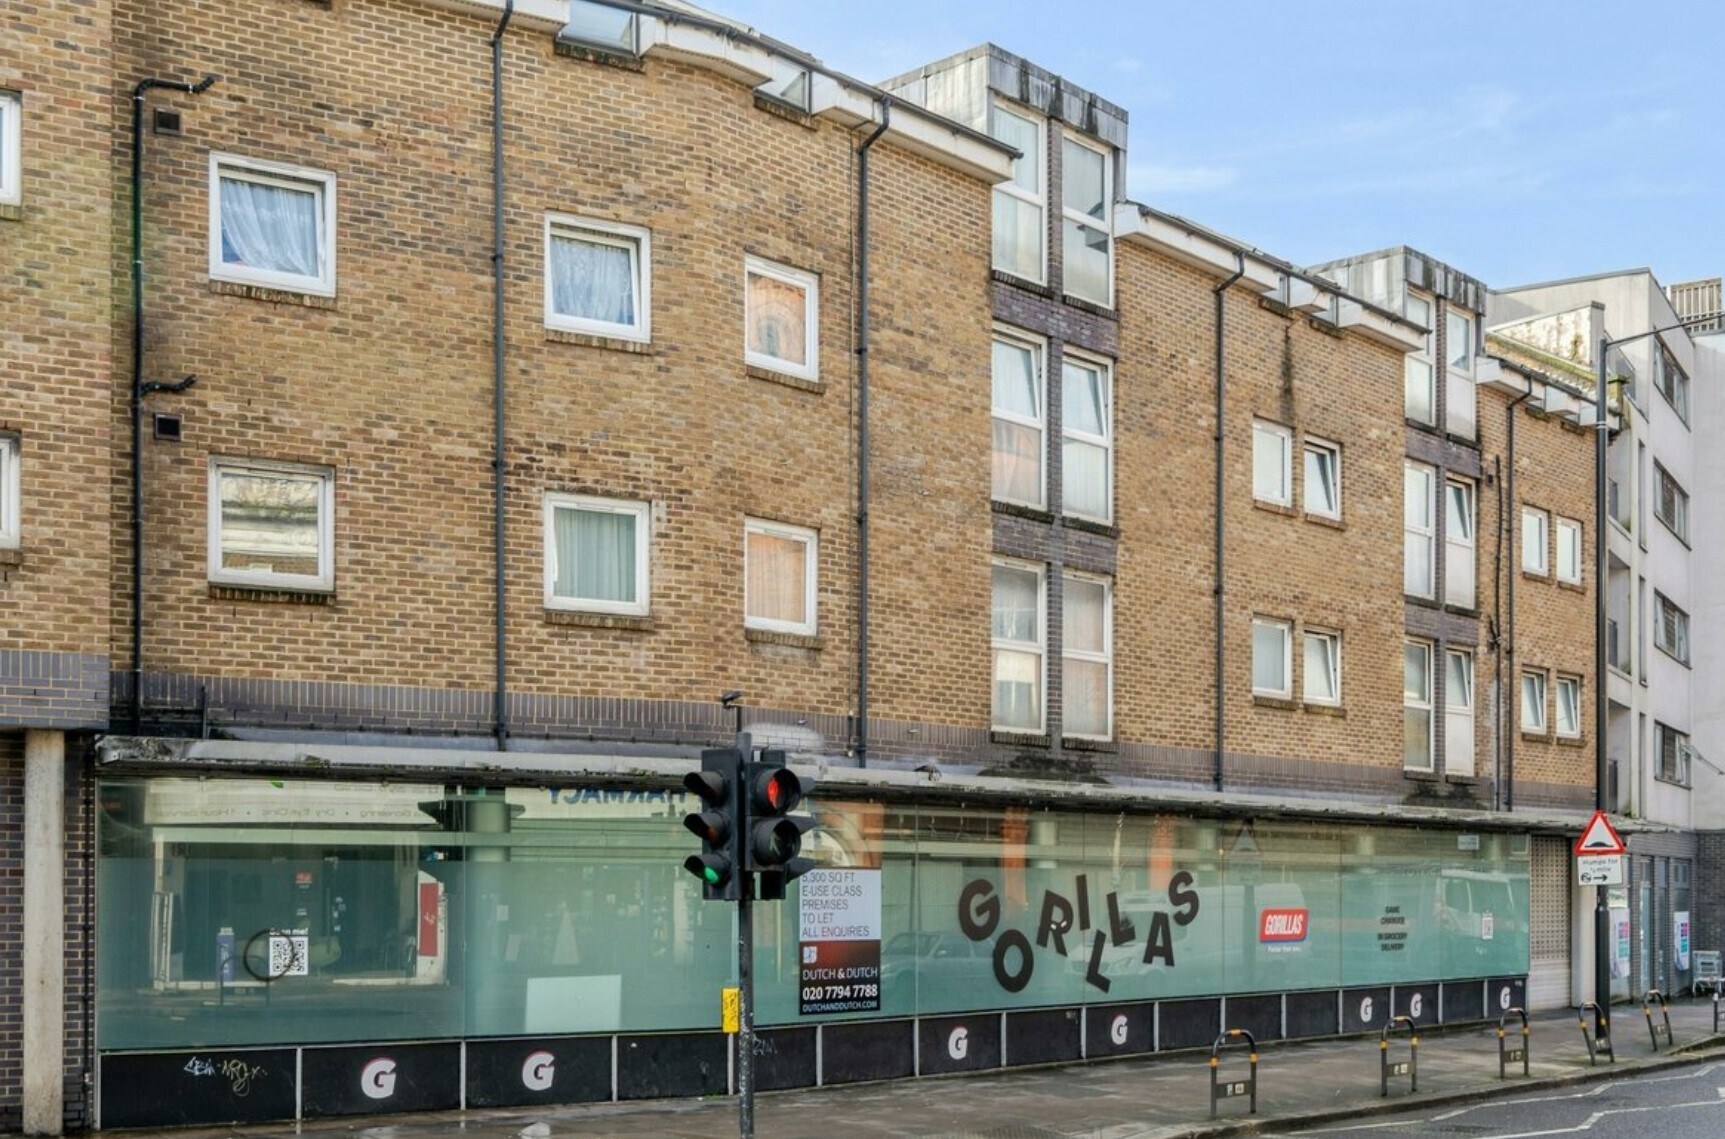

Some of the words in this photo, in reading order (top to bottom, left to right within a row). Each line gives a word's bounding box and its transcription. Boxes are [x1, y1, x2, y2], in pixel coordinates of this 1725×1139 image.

[828, 872, 842, 884] SQ
[844, 872, 855, 882] FT
[802, 885, 829, 897] E-USE
[831, 885, 863, 897] CLASS
[802, 899, 849, 911] PREMISES
[802, 913, 815, 924] TO
[817, 913, 834, 924] LET
[1264, 913, 1304, 936] GORILLAS
[802, 927, 818, 938] ALL
[821, 925, 870, 937] ENQUIRIES
[958, 870, 1200, 993] GORILLAS
[1381, 943, 1405, 951] DELIVERY
[802, 968, 836, 981] DUTCH
[837, 968, 845, 979] &
[846, 966, 878, 979] DUTCH
[802, 986, 823, 1001] 020
[824, 985, 851, 1000] 7794
[852, 984, 878, 998] 7788
[1501, 986, 1510, 1010] G
[802, 1001, 878, 1012] DUTCHANDDUTCH.COM
[1360, 996, 1373, 1022] G
[1410, 992, 1422, 1018] G
[1111, 1014, 1128, 1046] G
[949, 1026, 968, 1060] G
[361, 1057, 397, 1099] G
[522, 1050, 555, 1092] G
